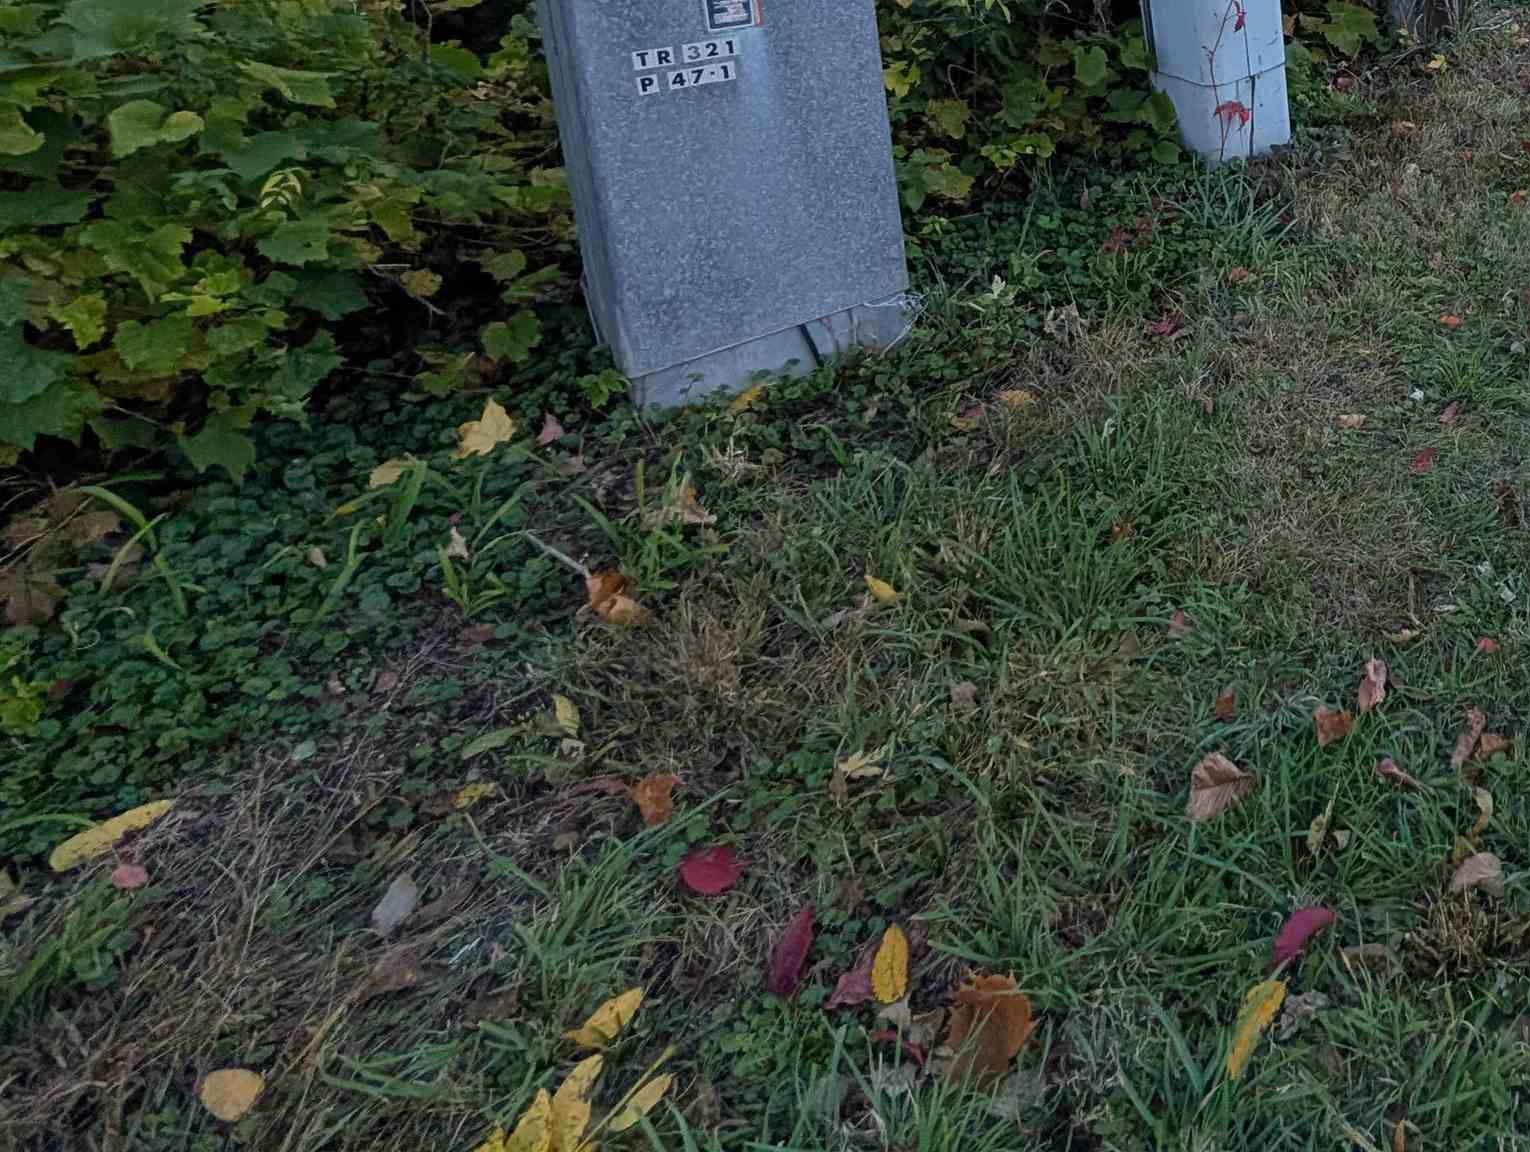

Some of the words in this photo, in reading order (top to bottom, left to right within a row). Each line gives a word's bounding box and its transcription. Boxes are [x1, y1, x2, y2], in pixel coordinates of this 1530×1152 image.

[636, 50, 672, 66] TR
[687, 40, 734, 60] 321
[640, 77, 654, 92] P
